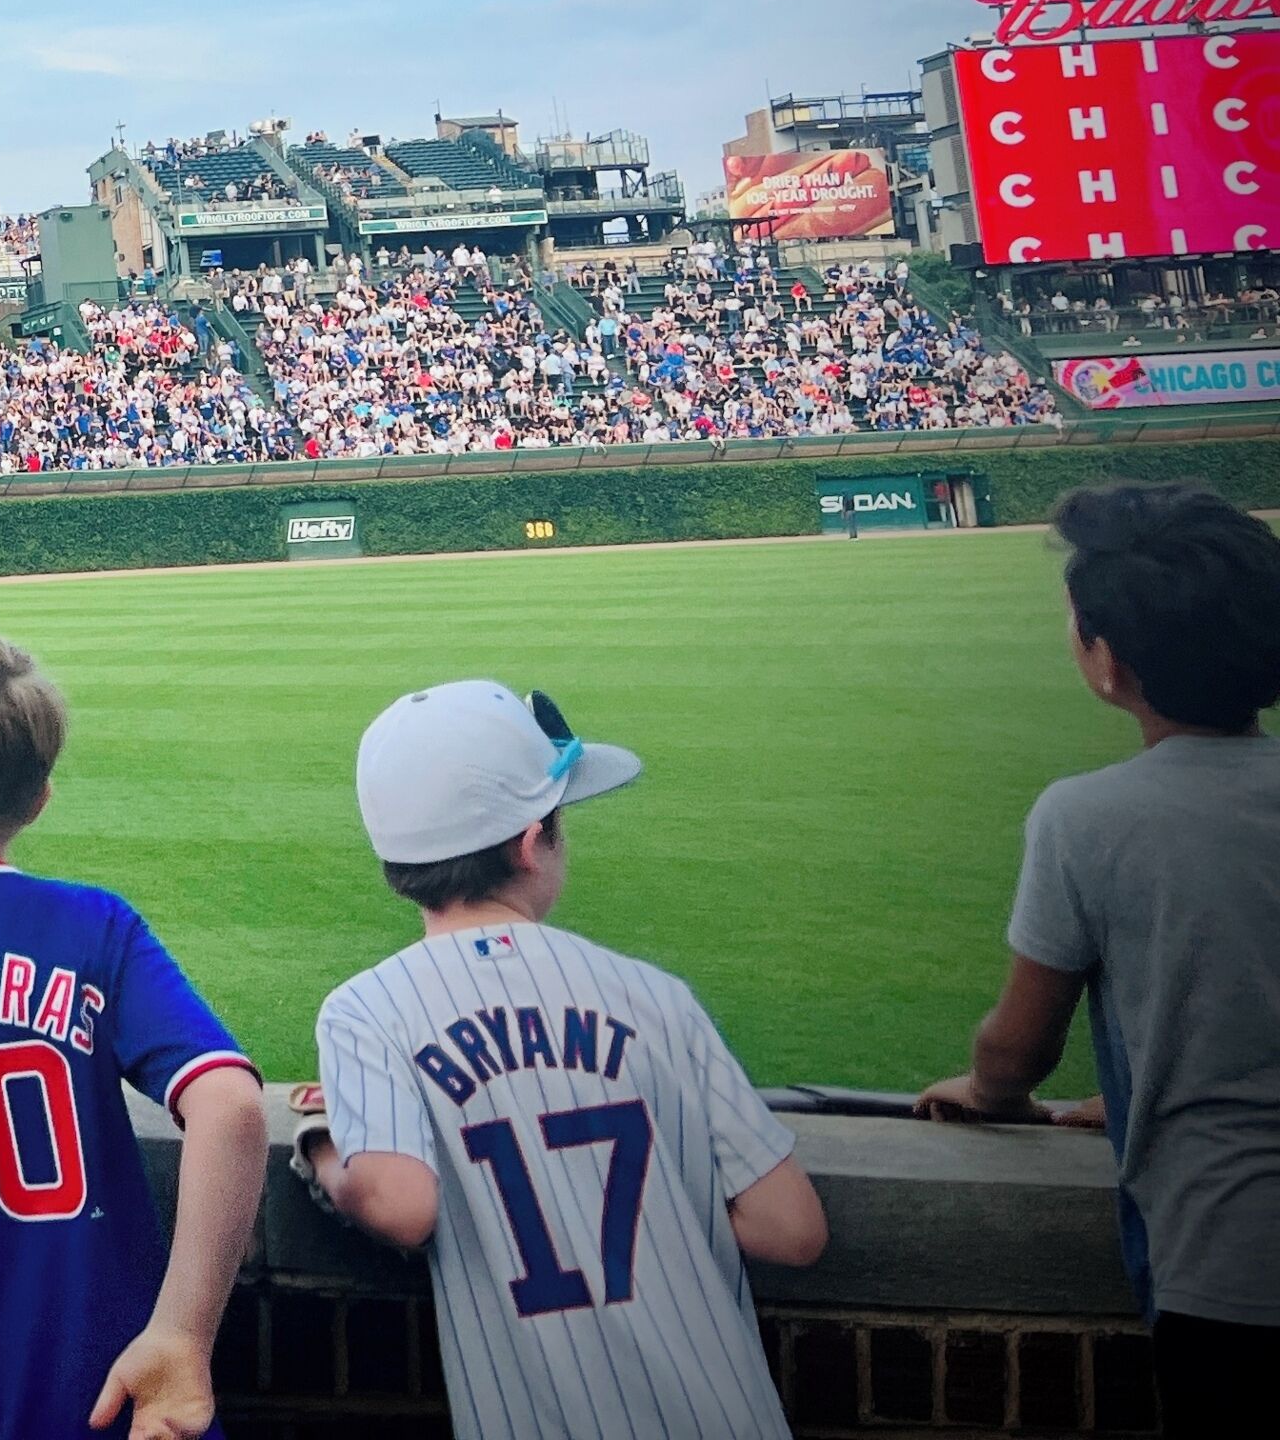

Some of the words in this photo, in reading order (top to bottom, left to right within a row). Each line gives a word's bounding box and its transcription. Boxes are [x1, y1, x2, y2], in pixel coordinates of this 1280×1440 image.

[763, 174, 801, 190] DRIER
[805, 172, 840, 187] THAN
[844, 171, 854, 185] A
[811, 185, 877, 201] DROUGHT.
[197, 209, 310, 224] WRIGLEYROOFTOPS.COM
[396, 214, 511, 230] WRIGLEYROOFTOPS.COM
[291, 521, 351, 539] Hefty
[413, 1006, 637, 1107] BRYANT
[461, 1099, 655, 1318] 17
